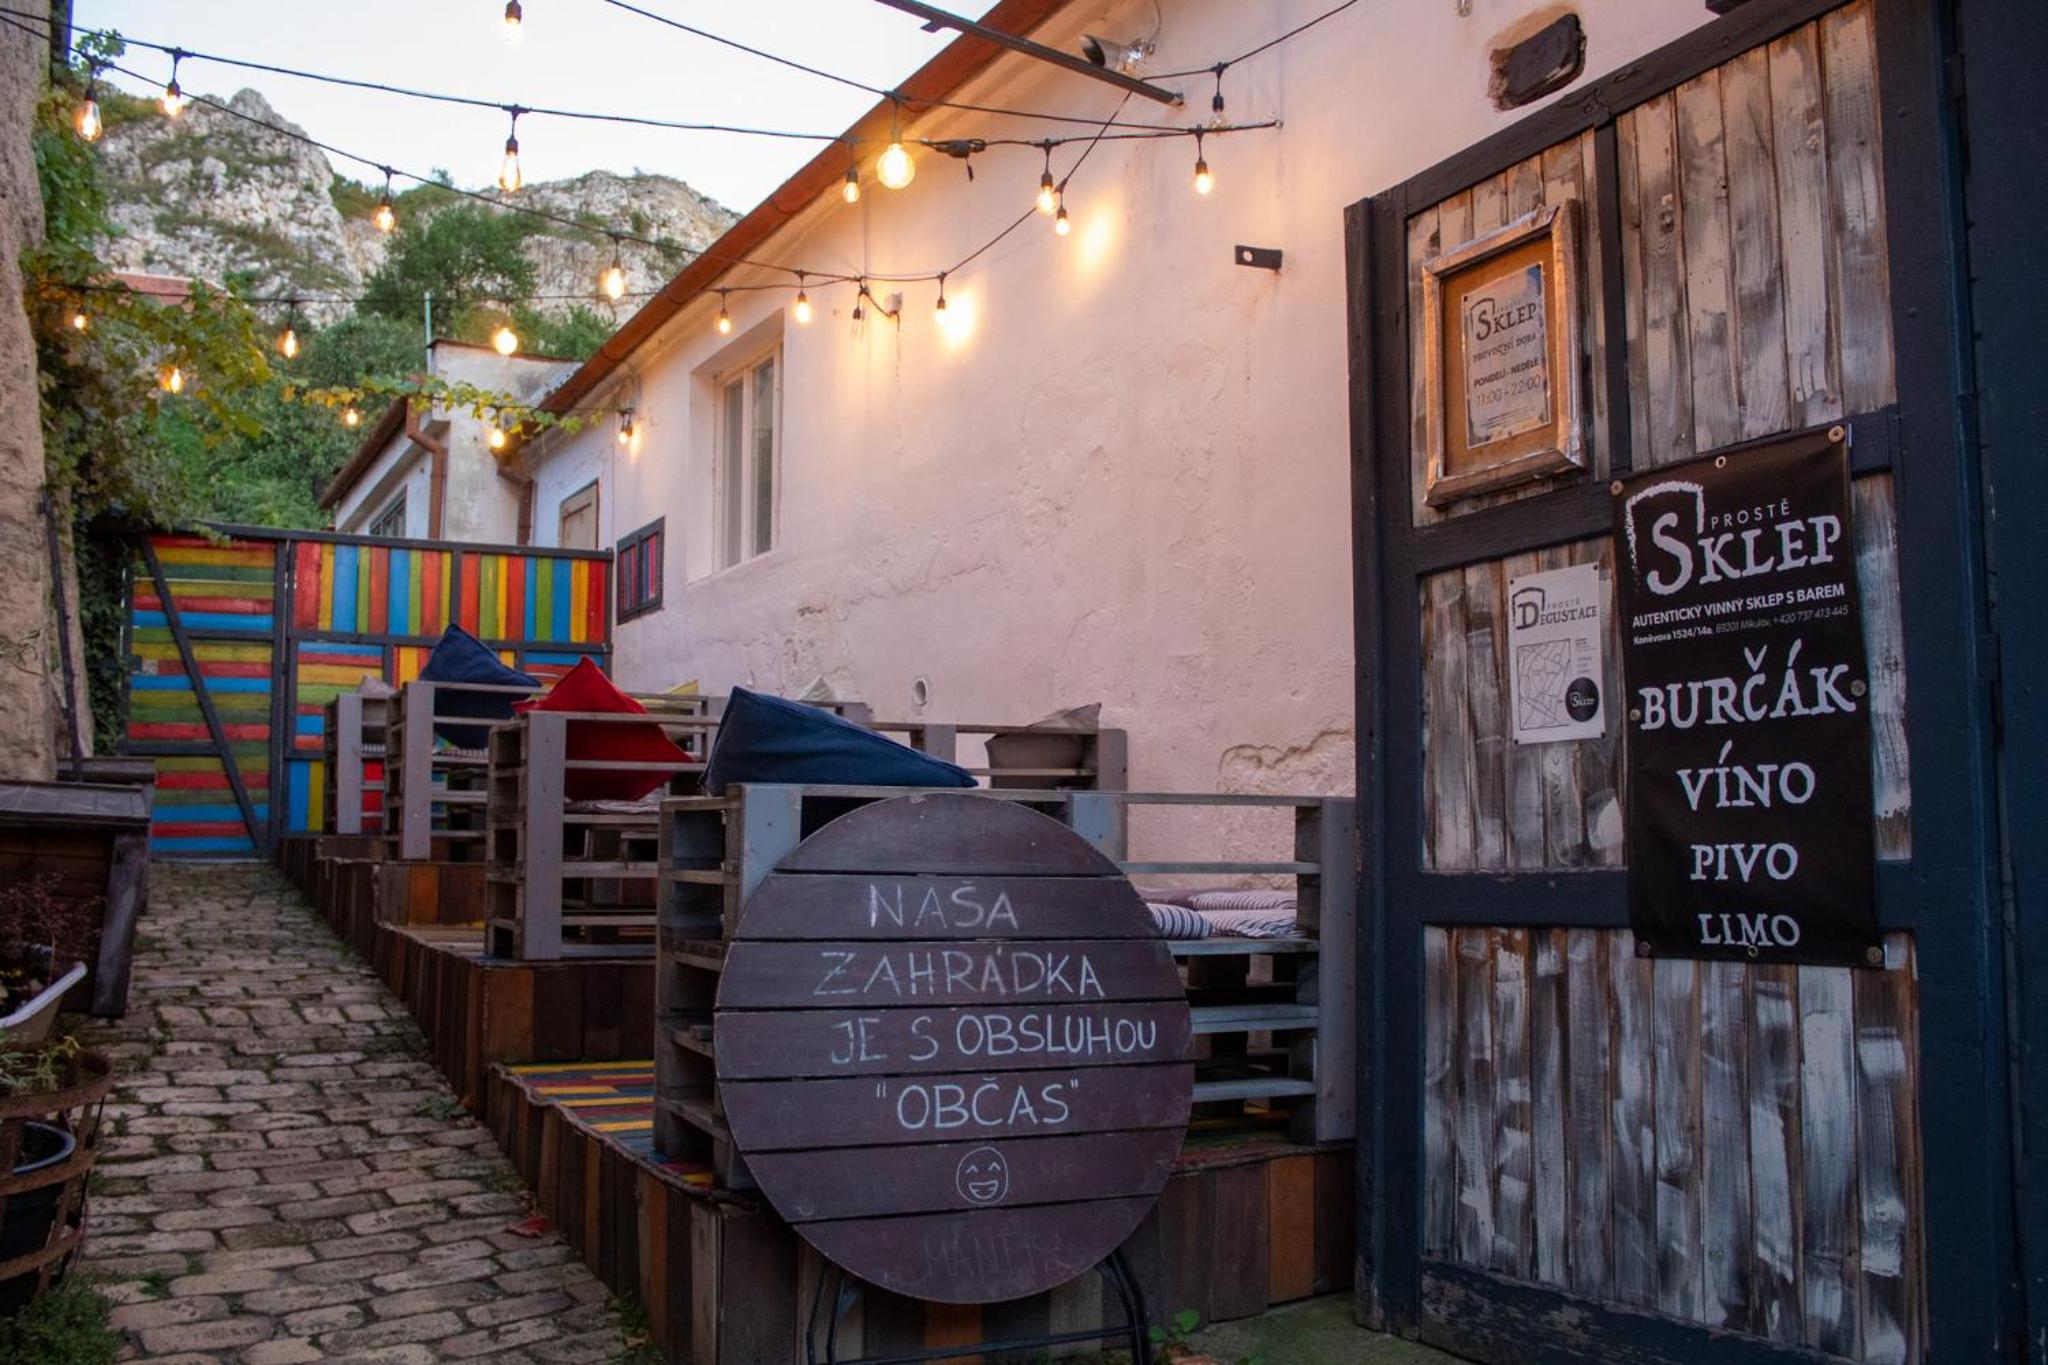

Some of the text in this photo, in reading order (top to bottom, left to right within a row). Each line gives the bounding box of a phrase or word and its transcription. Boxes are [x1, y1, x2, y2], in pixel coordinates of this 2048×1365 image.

[1476, 302, 1537, 341] SKLEP
[1647, 512, 1841, 596] SKLEP
[1516, 601, 1597, 630] DEGUSTACE
[1704, 597, 1744, 617] VINNÝ
[1746, 592, 1784, 610] SKLEP
[1786, 590, 1795, 604] S
[1796, 583, 1845, 602] BAREM
[1638, 638, 1857, 730] BURČÁK
[1676, 739, 1816, 811] VÍNO
[1690, 843, 1798, 882] PIVO
[870, 880, 1018, 928] NAŠA
[1698, 913, 1800, 947] LIMO
[813, 946, 1105, 997] ZAHRÁDKA
[831, 1014, 1157, 1065] JE S OBSLUHOU
[876, 1076, 1080, 1130] "OBČAS"
